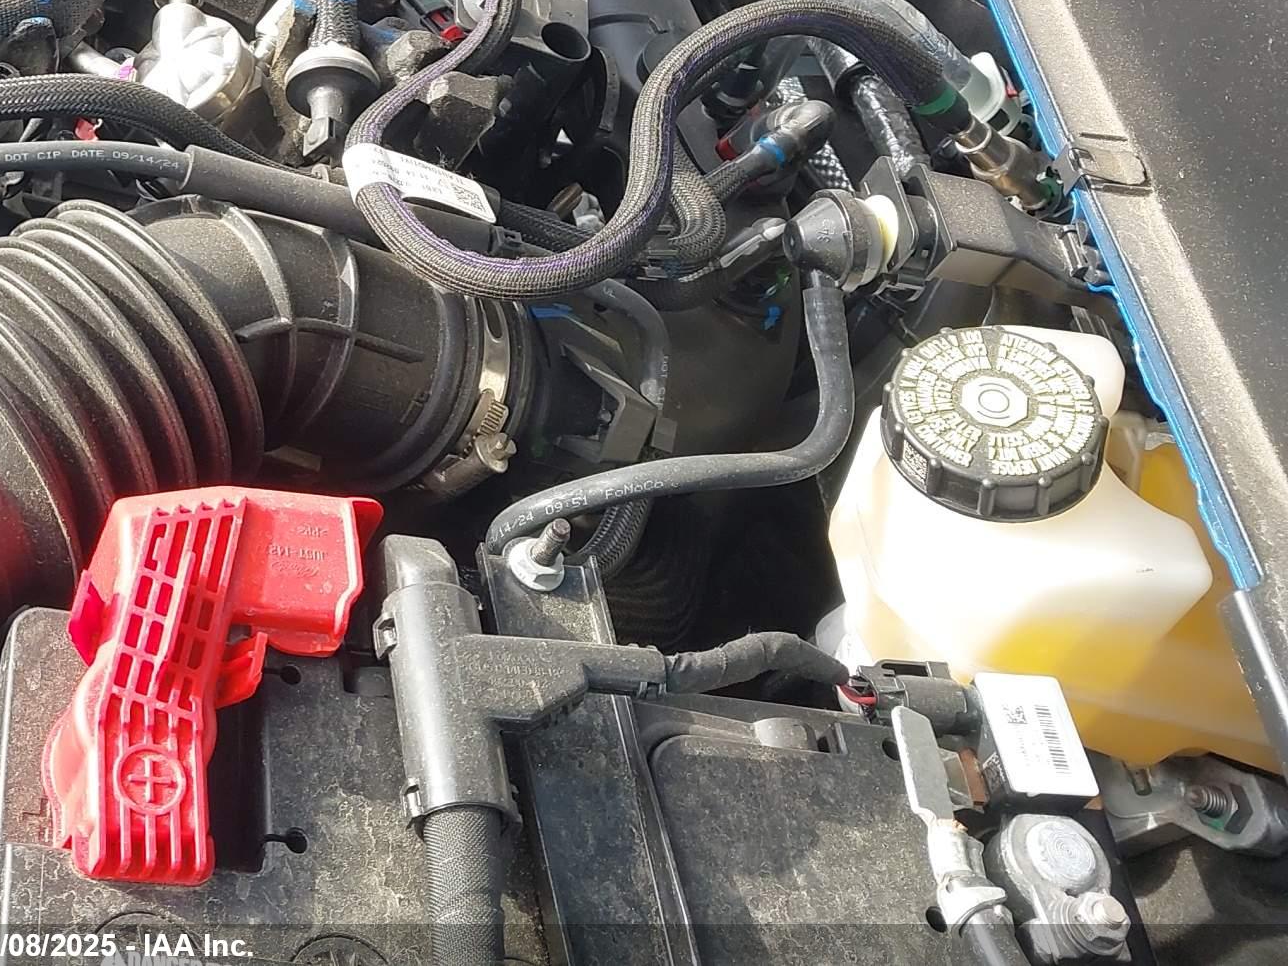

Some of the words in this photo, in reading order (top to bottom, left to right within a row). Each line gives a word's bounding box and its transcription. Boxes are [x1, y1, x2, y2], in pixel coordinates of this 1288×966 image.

[5, 152, 28, 163] DOT
[71, 149, 105, 159] DATE
[915, 336, 952, 359] FLUID
[959, 330, 984, 345] DOT
[999, 332, 1058, 363] ATTENTION
[900, 354, 928, 379] FROM
[896, 389, 924, 424] SEALED
[922, 414, 952, 434] USE
[907, 423, 974, 467] CONTAINER
[544, 495, 588, 516] 09:51
[604, 480, 664, 500] FoMoCo
